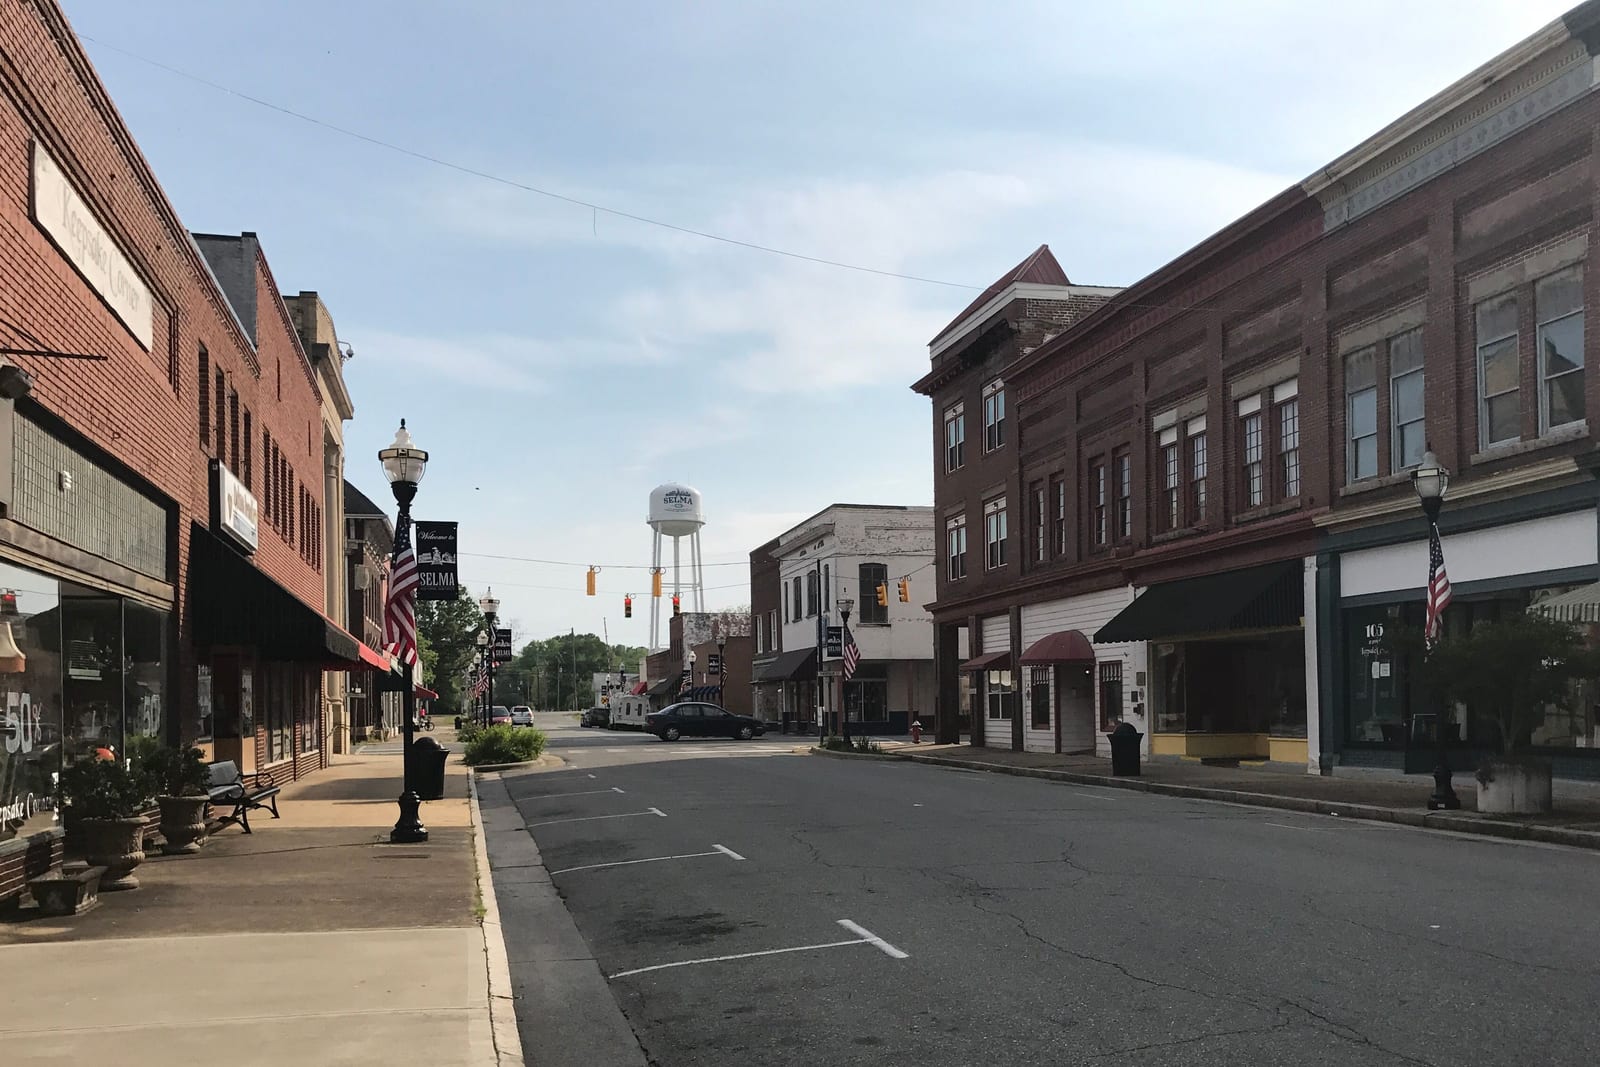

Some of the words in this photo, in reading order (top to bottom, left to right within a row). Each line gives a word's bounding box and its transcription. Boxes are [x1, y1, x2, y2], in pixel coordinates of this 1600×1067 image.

[57, 179, 107, 274] Keepsake
[107, 250, 140, 311] Corner
[663, 496, 693, 505] SELMA
[417, 530, 448, 540] Welcome
[420, 572, 455, 586] SELMA
[1365, 623, 1383, 638] 105
